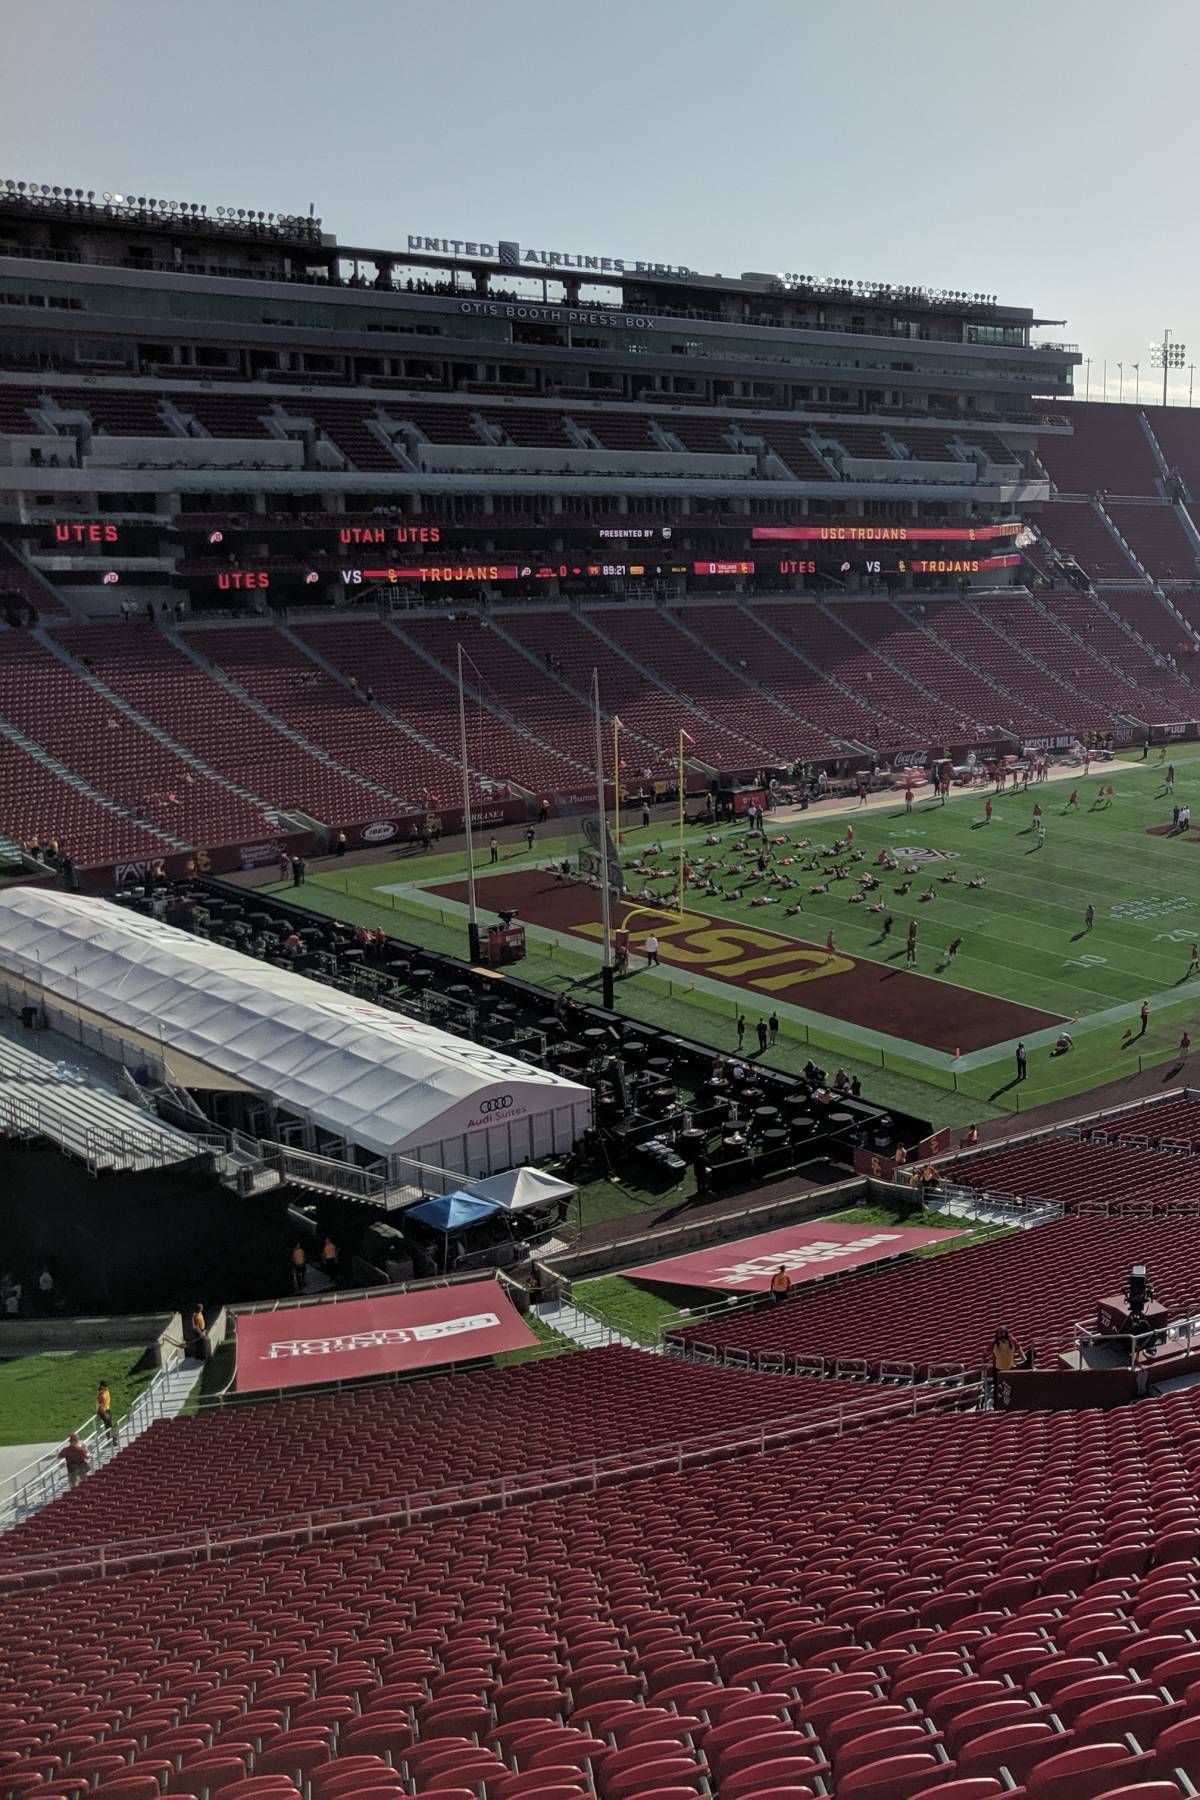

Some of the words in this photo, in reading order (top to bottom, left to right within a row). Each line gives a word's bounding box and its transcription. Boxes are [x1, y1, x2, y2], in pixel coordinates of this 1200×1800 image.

[408, 235, 494, 258] UNITED
[524, 249, 626, 272] AIRLINES
[635, 261, 692, 279] FIELD
[460, 302, 499, 316] OTIS
[506, 306, 562, 322] BOOTH
[568, 311, 618, 327] PRESS
[625, 317, 655, 329] BOX
[55, 525, 118, 542] UTES
[340, 528, 385, 544] UTAH
[396, 528, 440, 543] UTES
[599, 530, 642, 538] PRESENTED
[644, 530, 654, 538] BY
[820, 527, 848, 541] USC
[851, 527, 907, 541] TROJANS
[559, 566, 567, 576] 0
[602, 565, 626, 575] 89:21
[709, 562, 716, 574] 0
[779, 560, 816, 574] UTES
[865, 560, 881, 574] VS
[920, 559, 980, 573] TROJANS
[217, 572, 270, 589] UTES
[341, 570, 363, 585] VS
[419, 566, 498, 582] TROJANS
[1024, 737, 1055, 750] MUSCLE
[1056, 735, 1075, 748] MILK
[369, 826, 391, 836] IBEW
[1152, 929, 1199, 943] 20
[567, 906, 857, 991] USC
[1062, 954, 1107, 969] 10
[467, 1114, 493, 1128] Audi
[495, 1106, 528, 1120] Suites
[420, 1315, 494, 1337] USC
[260, 1335, 412, 1360] CREDIT
[271, 1329, 409, 1353] UNION
